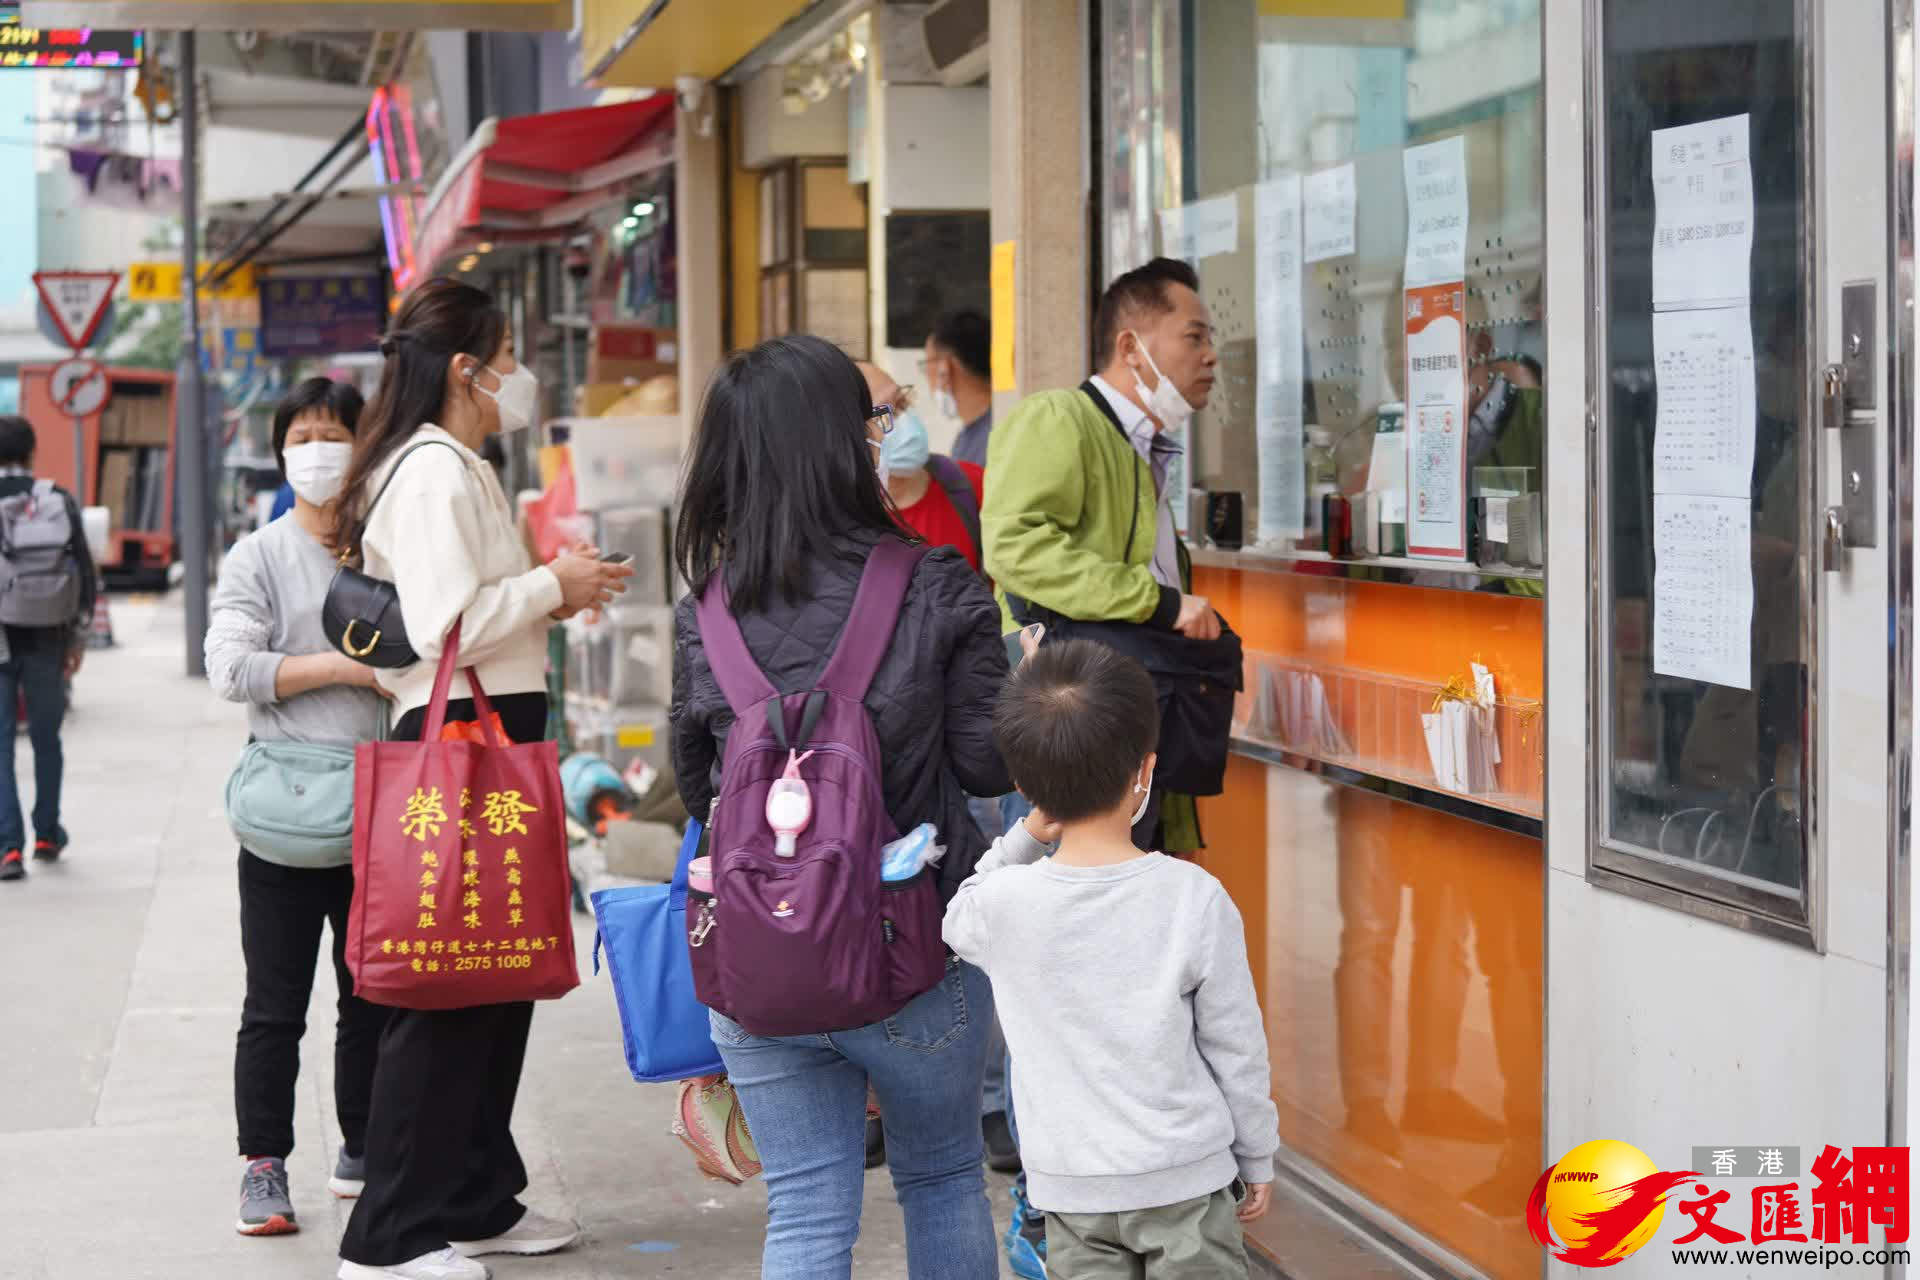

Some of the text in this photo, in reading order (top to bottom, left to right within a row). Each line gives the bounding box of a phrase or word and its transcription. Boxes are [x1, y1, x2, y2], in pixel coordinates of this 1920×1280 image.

[380, 935, 559, 956] 香港灣仔道七十二號地下
[455, 954, 493, 971] 2575
[496, 953, 532, 969] 1008
